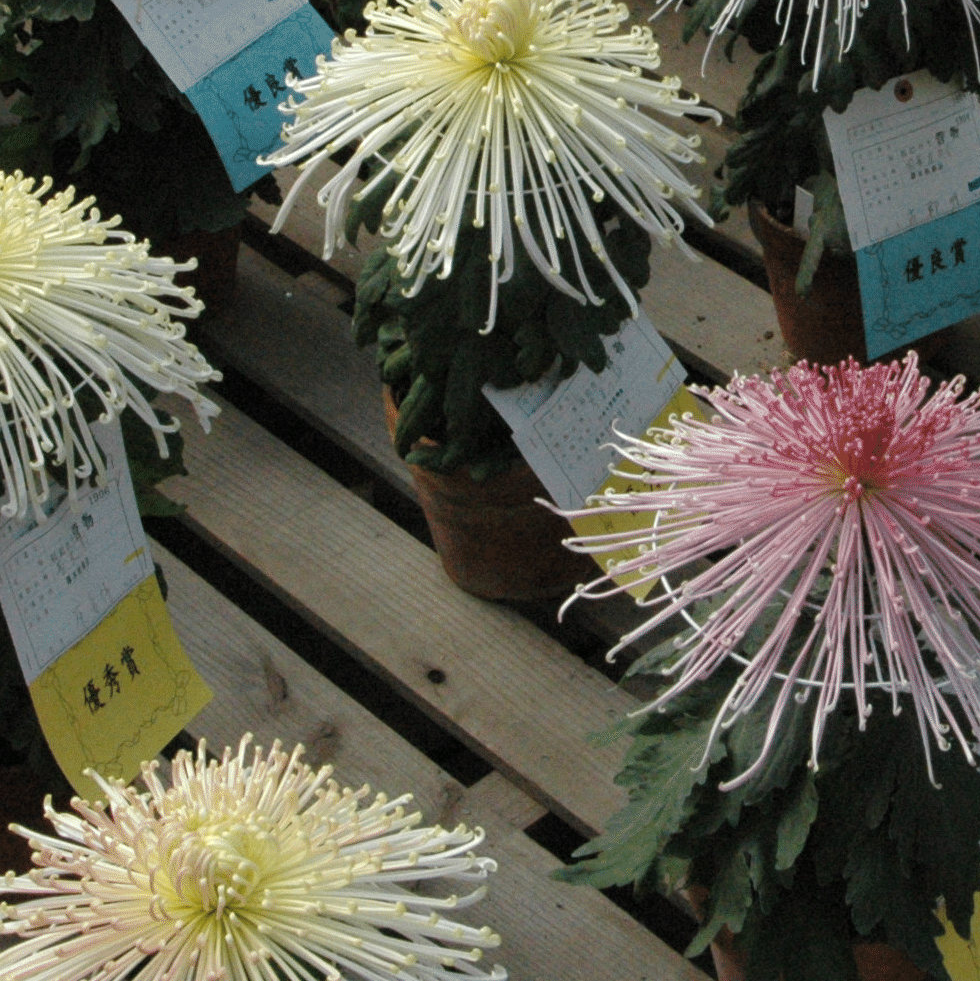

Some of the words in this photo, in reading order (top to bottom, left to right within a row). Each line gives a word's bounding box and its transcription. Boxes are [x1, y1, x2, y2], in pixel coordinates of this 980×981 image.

[903, 236, 968, 284] 優良賞
[82, 645, 141, 716] 優秀賞
